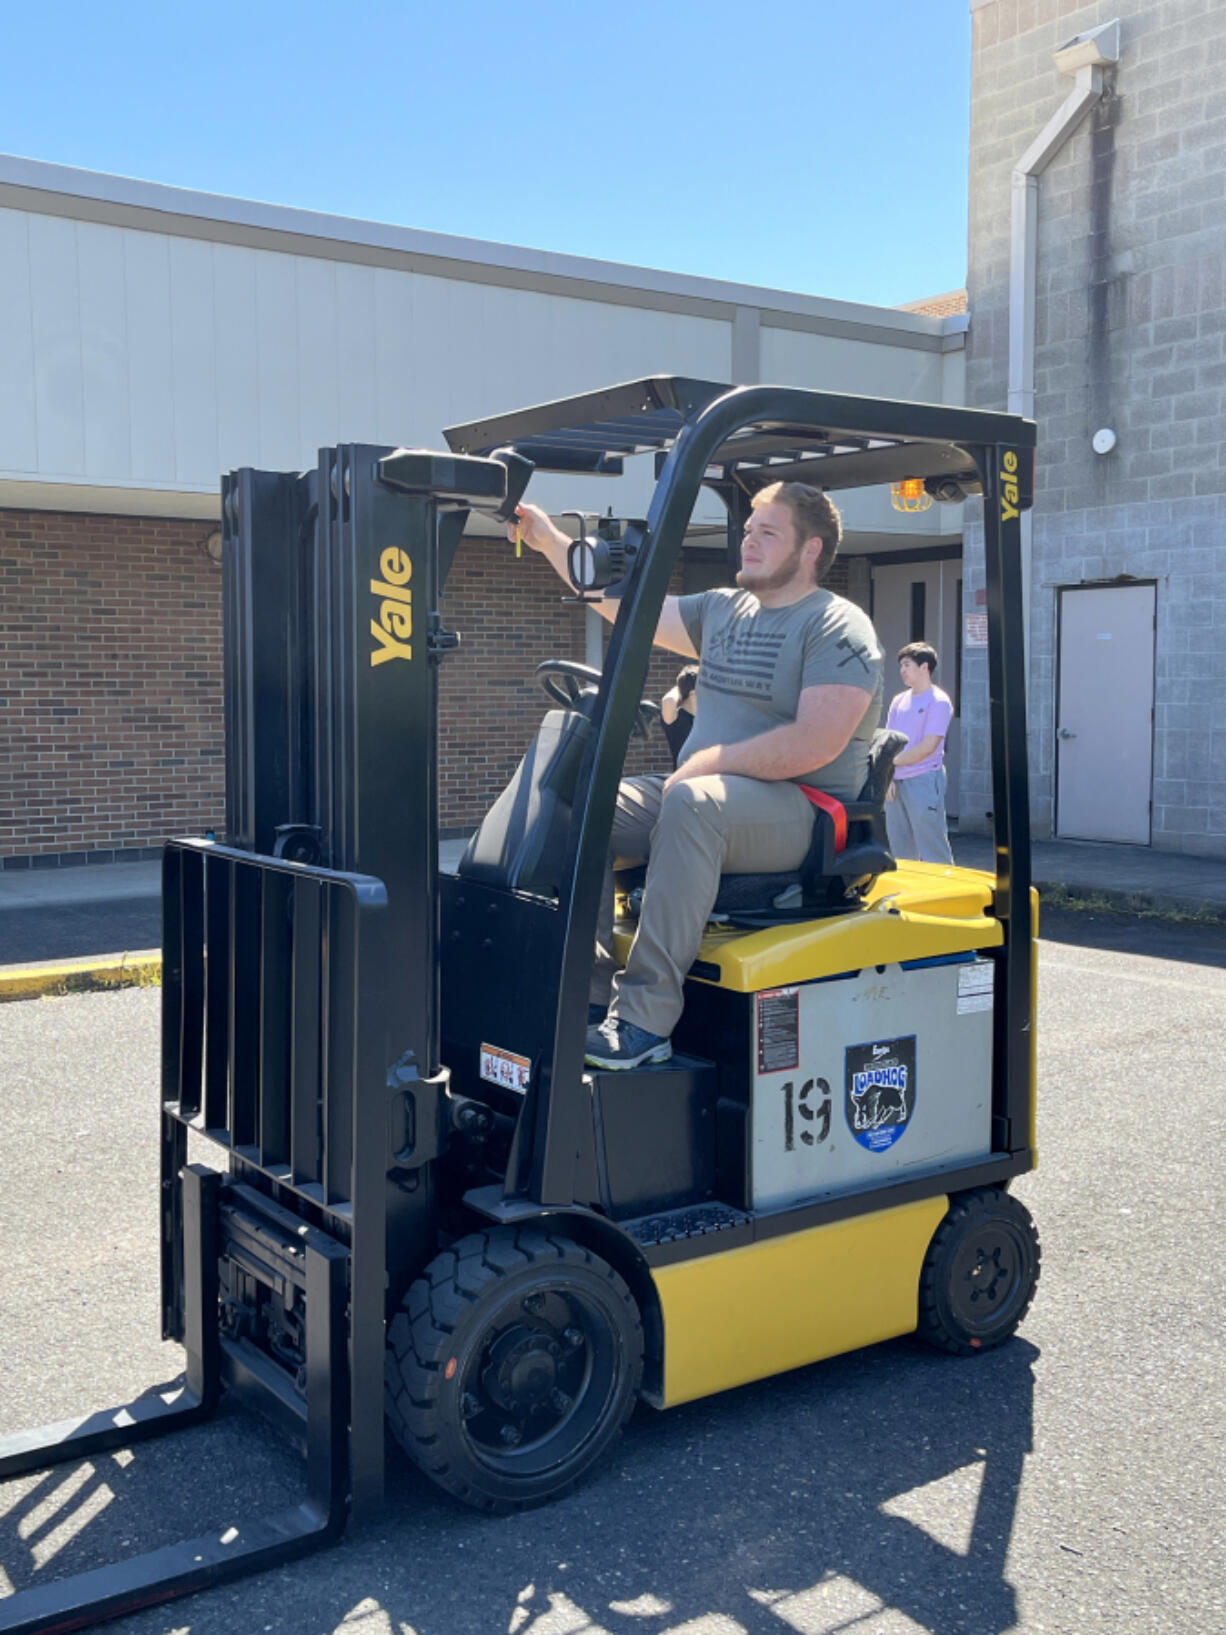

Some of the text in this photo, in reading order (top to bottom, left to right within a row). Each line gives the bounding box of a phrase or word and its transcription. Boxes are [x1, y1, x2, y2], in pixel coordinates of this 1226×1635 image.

[1000, 450, 1019, 522] Yale
[370, 546, 412, 667] Yale
[780, 1077, 832, 1153] 19
[853, 1065, 907, 1096] LOADHOG
